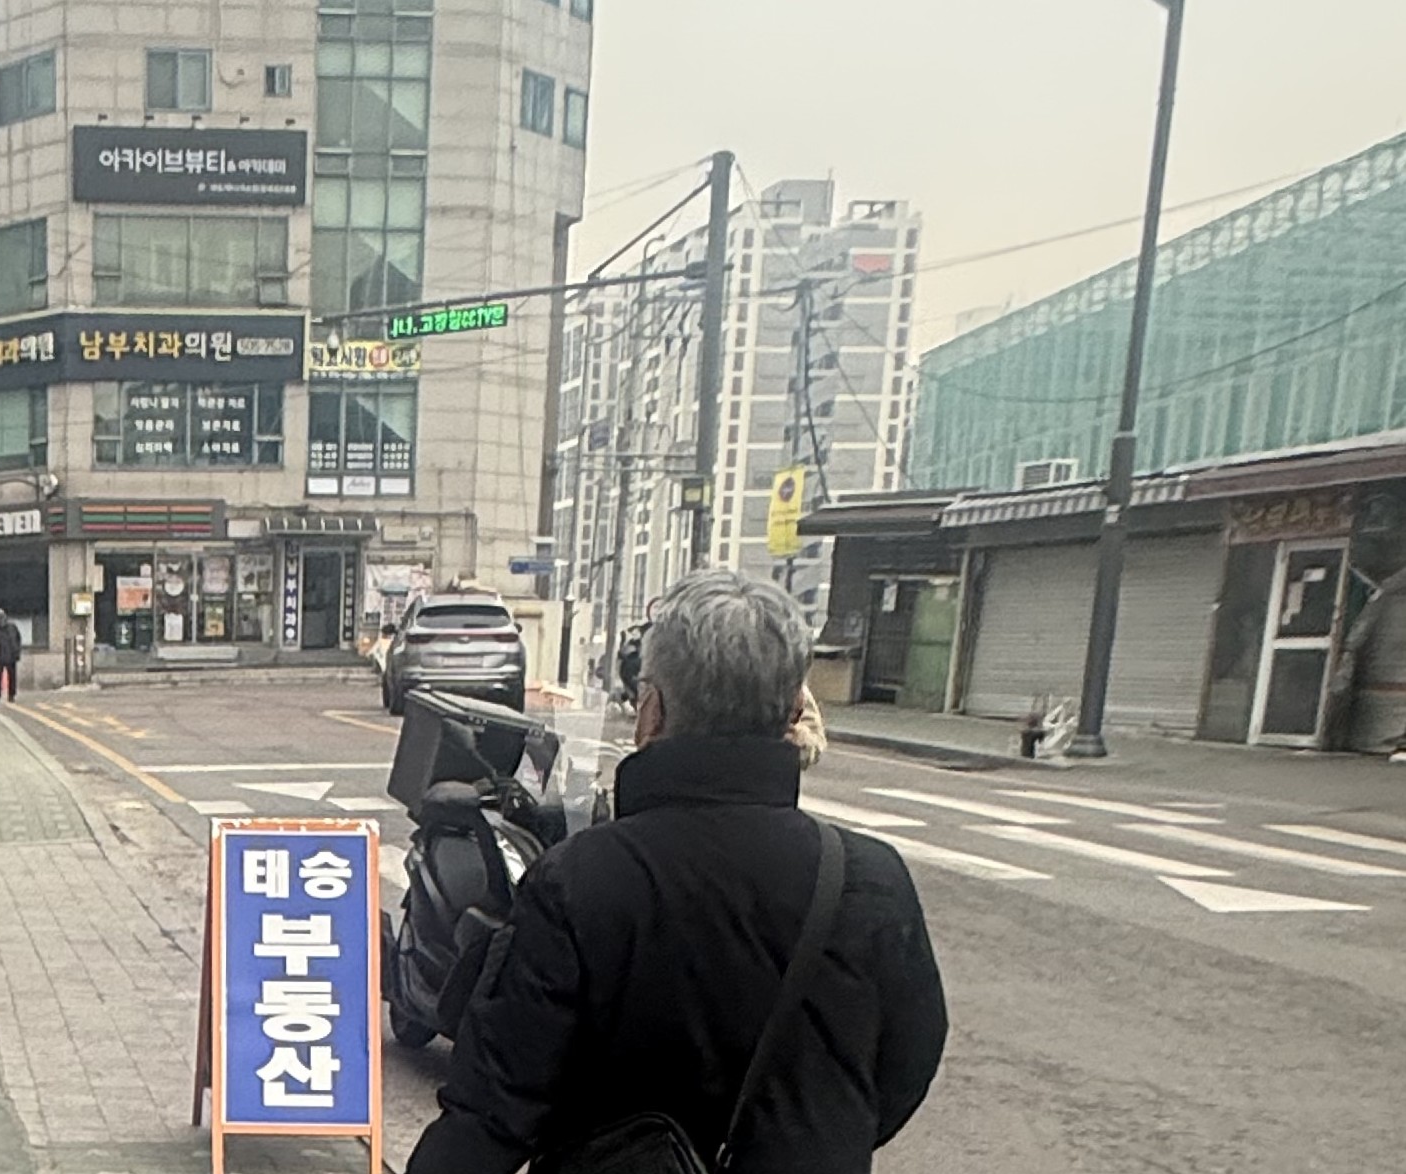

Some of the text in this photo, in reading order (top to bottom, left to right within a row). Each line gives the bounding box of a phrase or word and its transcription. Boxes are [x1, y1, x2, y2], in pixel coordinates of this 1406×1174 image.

[79, 330, 232, 362] 남부치과의원
[242, 848, 353, 899] 태승
[252, 913, 341, 1108] 부동산
